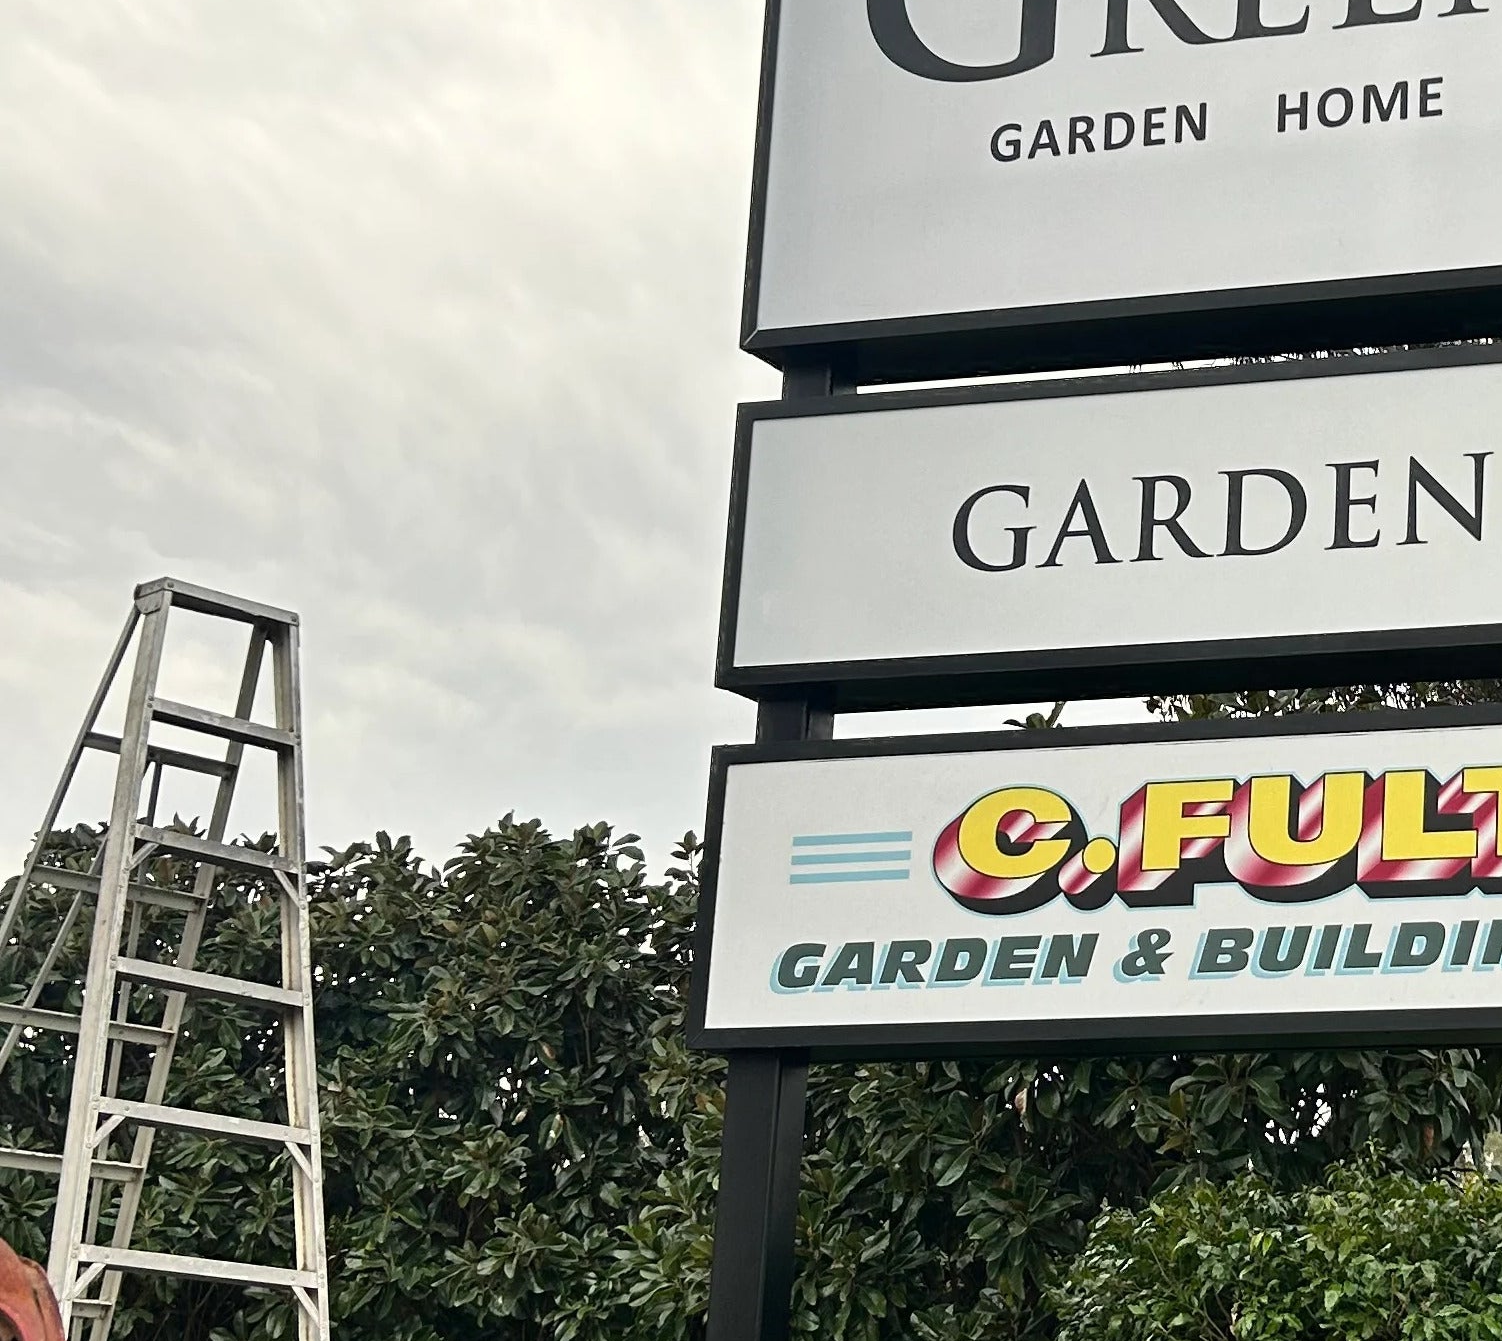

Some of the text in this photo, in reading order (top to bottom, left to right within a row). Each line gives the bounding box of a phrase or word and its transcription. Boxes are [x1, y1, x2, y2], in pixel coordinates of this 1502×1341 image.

[990, 102, 1207, 163] GARDEN
[1277, 76, 1444, 133] HOME
[952, 451, 1494, 573] GARDEN
[770, 932, 1100, 995] GARDEN
[1113, 928, 1175, 981] &
